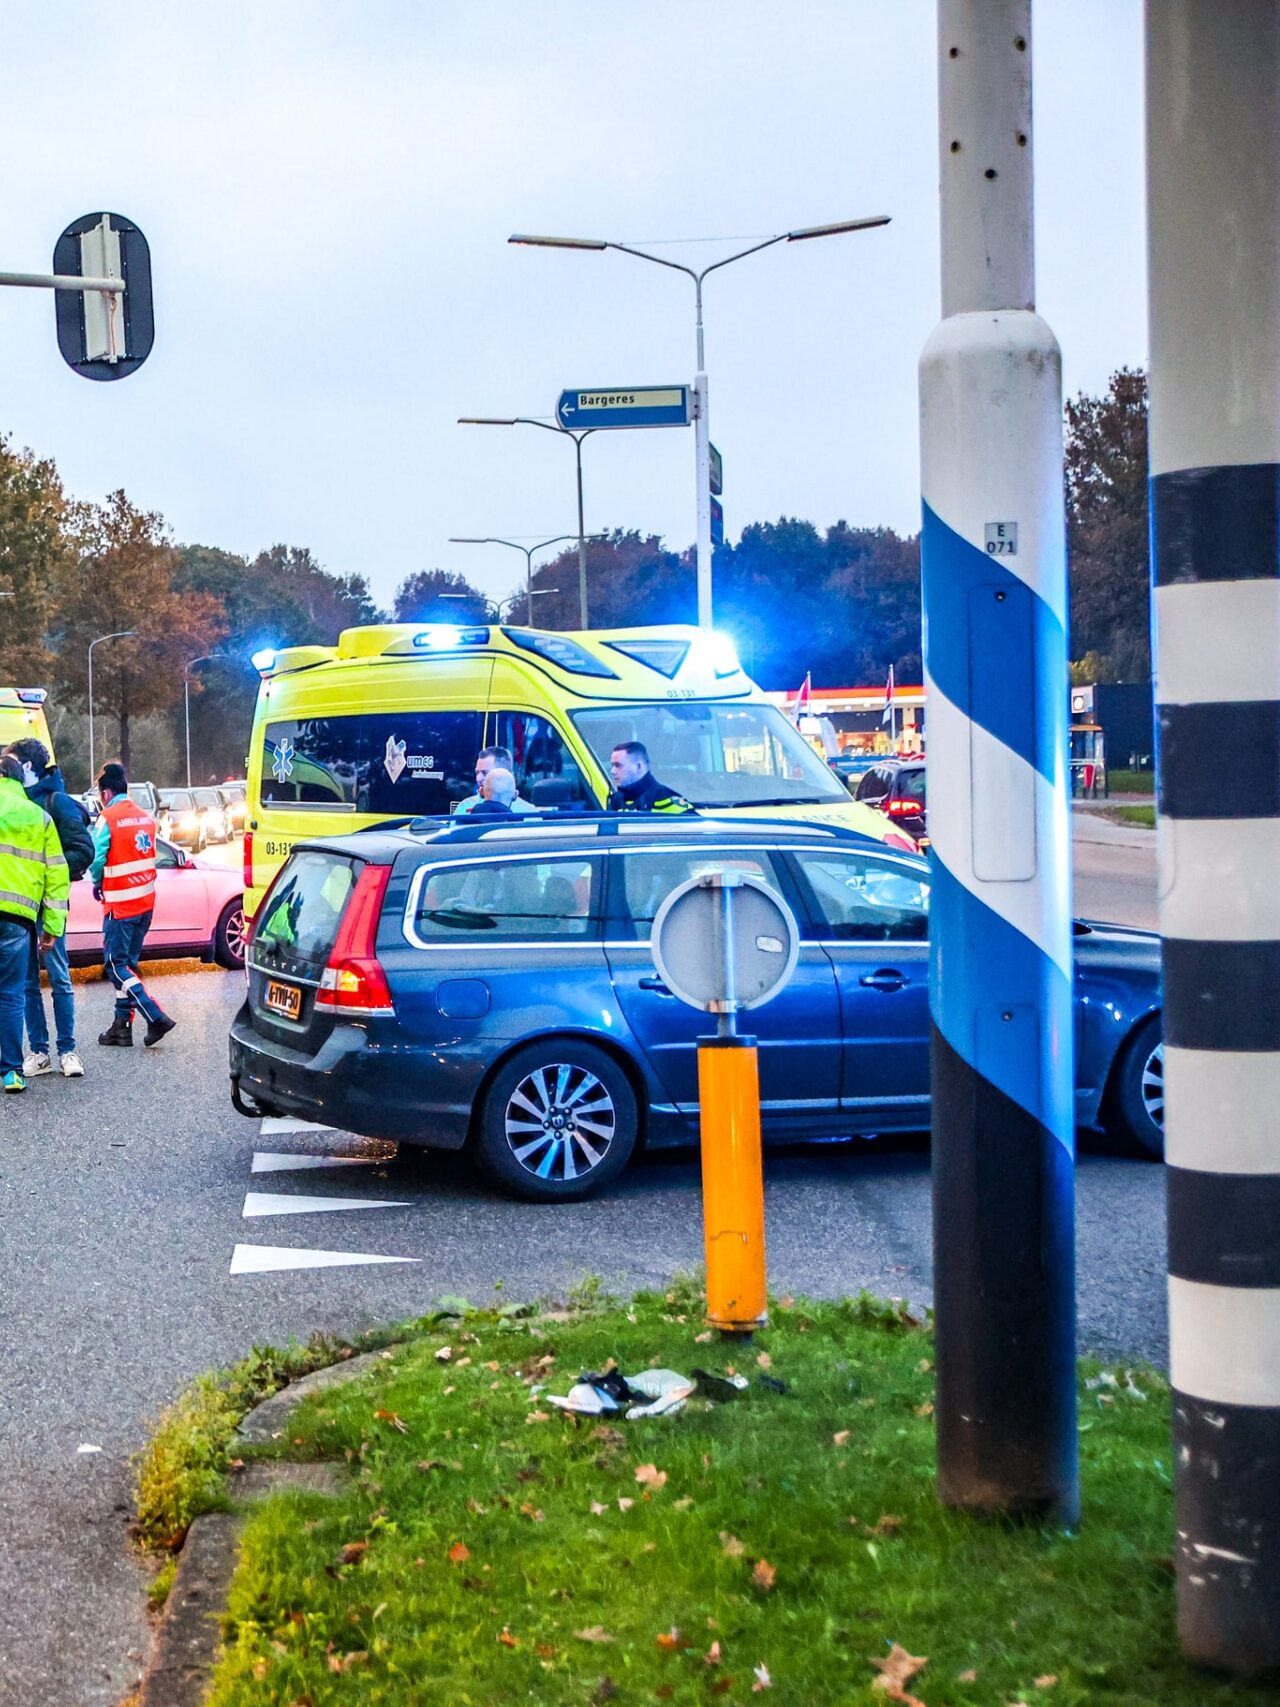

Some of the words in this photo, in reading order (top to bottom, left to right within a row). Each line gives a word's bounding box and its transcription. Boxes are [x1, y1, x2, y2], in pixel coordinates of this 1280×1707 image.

[580, 394, 636, 408] Bargeres
[997, 524, 1005, 537] E
[986, 541, 1015, 554] 071
